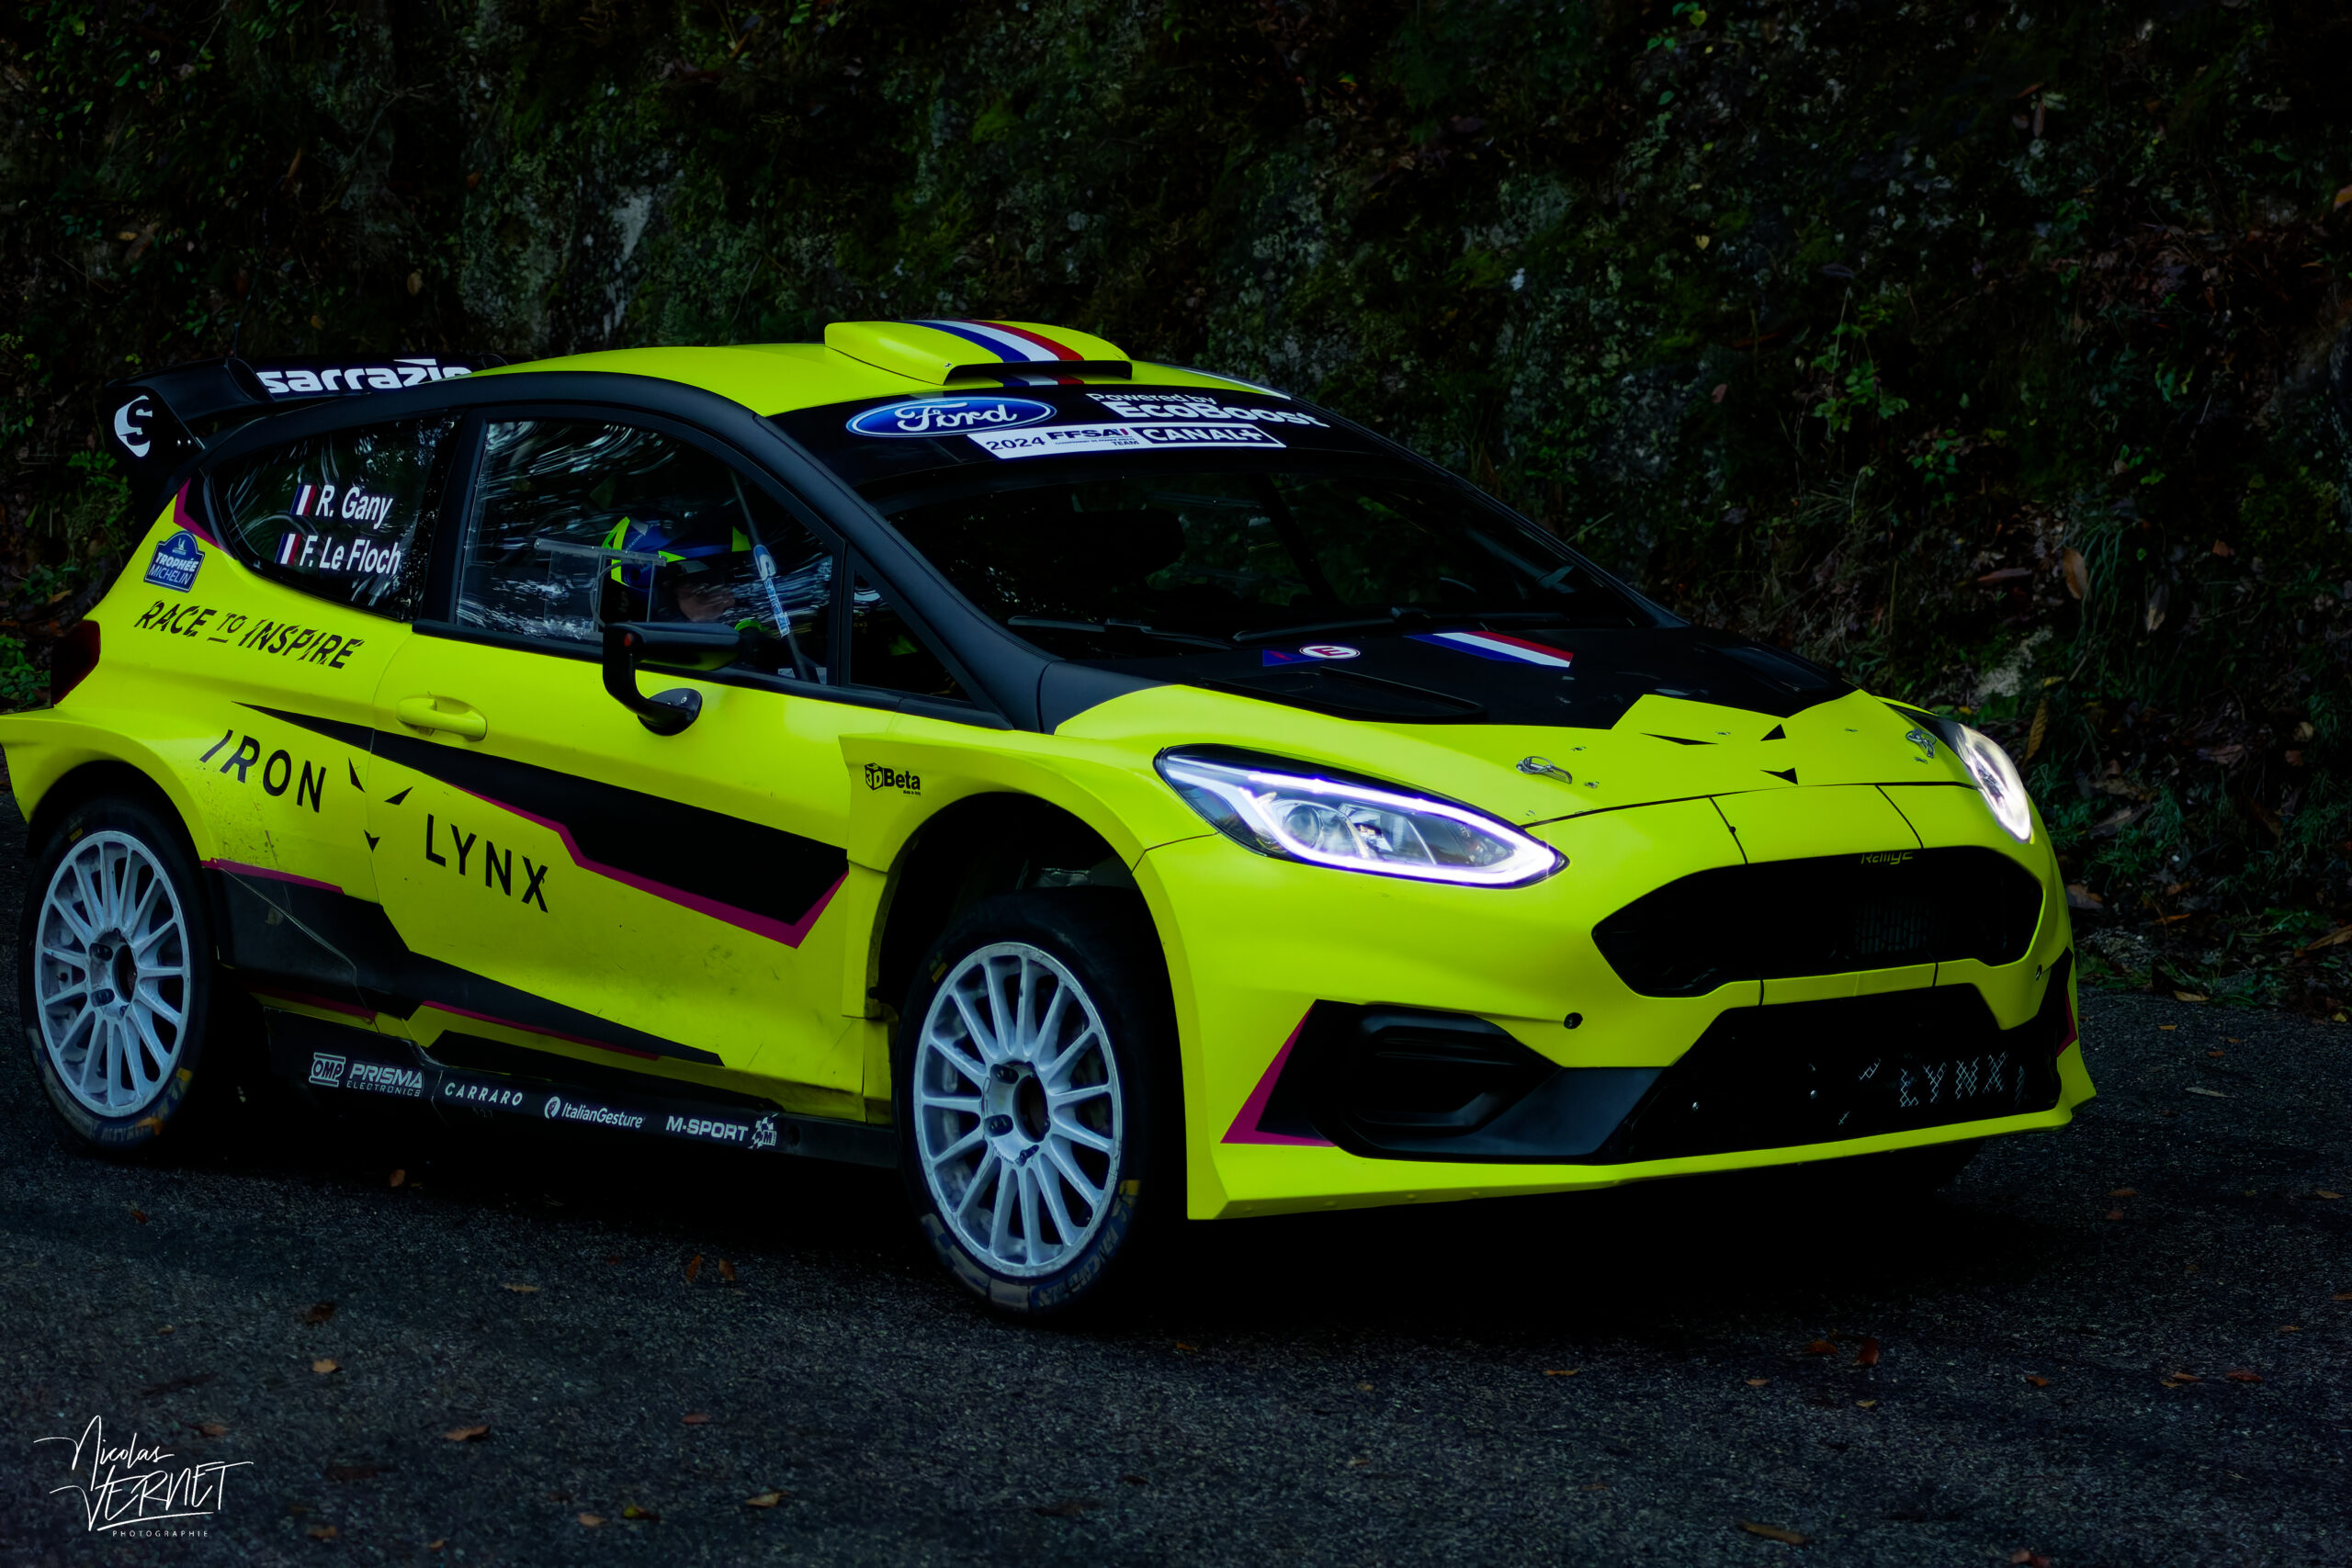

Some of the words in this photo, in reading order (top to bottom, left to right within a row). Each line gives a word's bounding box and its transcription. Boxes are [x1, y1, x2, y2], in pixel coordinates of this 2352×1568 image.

[1085, 393, 1186, 403] Powered
[1185, 394, 1217, 405] by
[896, 400, 1017, 432] Ford
[1102, 401, 1330, 428] EcoBoost
[986, 437, 1046, 450] 2024
[1046, 429, 1121, 440] FFSA
[1142, 428, 1263, 442] CANAL+
[315, 485, 335, 516] R.
[341, 488, 393, 529] Gany
[154, 552, 199, 573] TROPHÉE
[299, 536, 315, 567] F.
[318, 536, 344, 570] Le
[346, 539, 401, 575] Floch
[149, 564, 193, 585] MICHELIN
[134, 600, 218, 637] RACE
[216, 612, 248, 634] TO
[237, 618, 365, 669] INSPIRE
[884, 768, 921, 790] Beta
[198, 729, 327, 813] IRON
[425, 813, 548, 914] LYNX
[349, 1063, 423, 1089] PRISMA
[345, 1079, 422, 1098] ELECTRONICS
[444, 1082, 523, 1106] CARRARO
[561, 1102, 644, 1129] ItalianGesture
